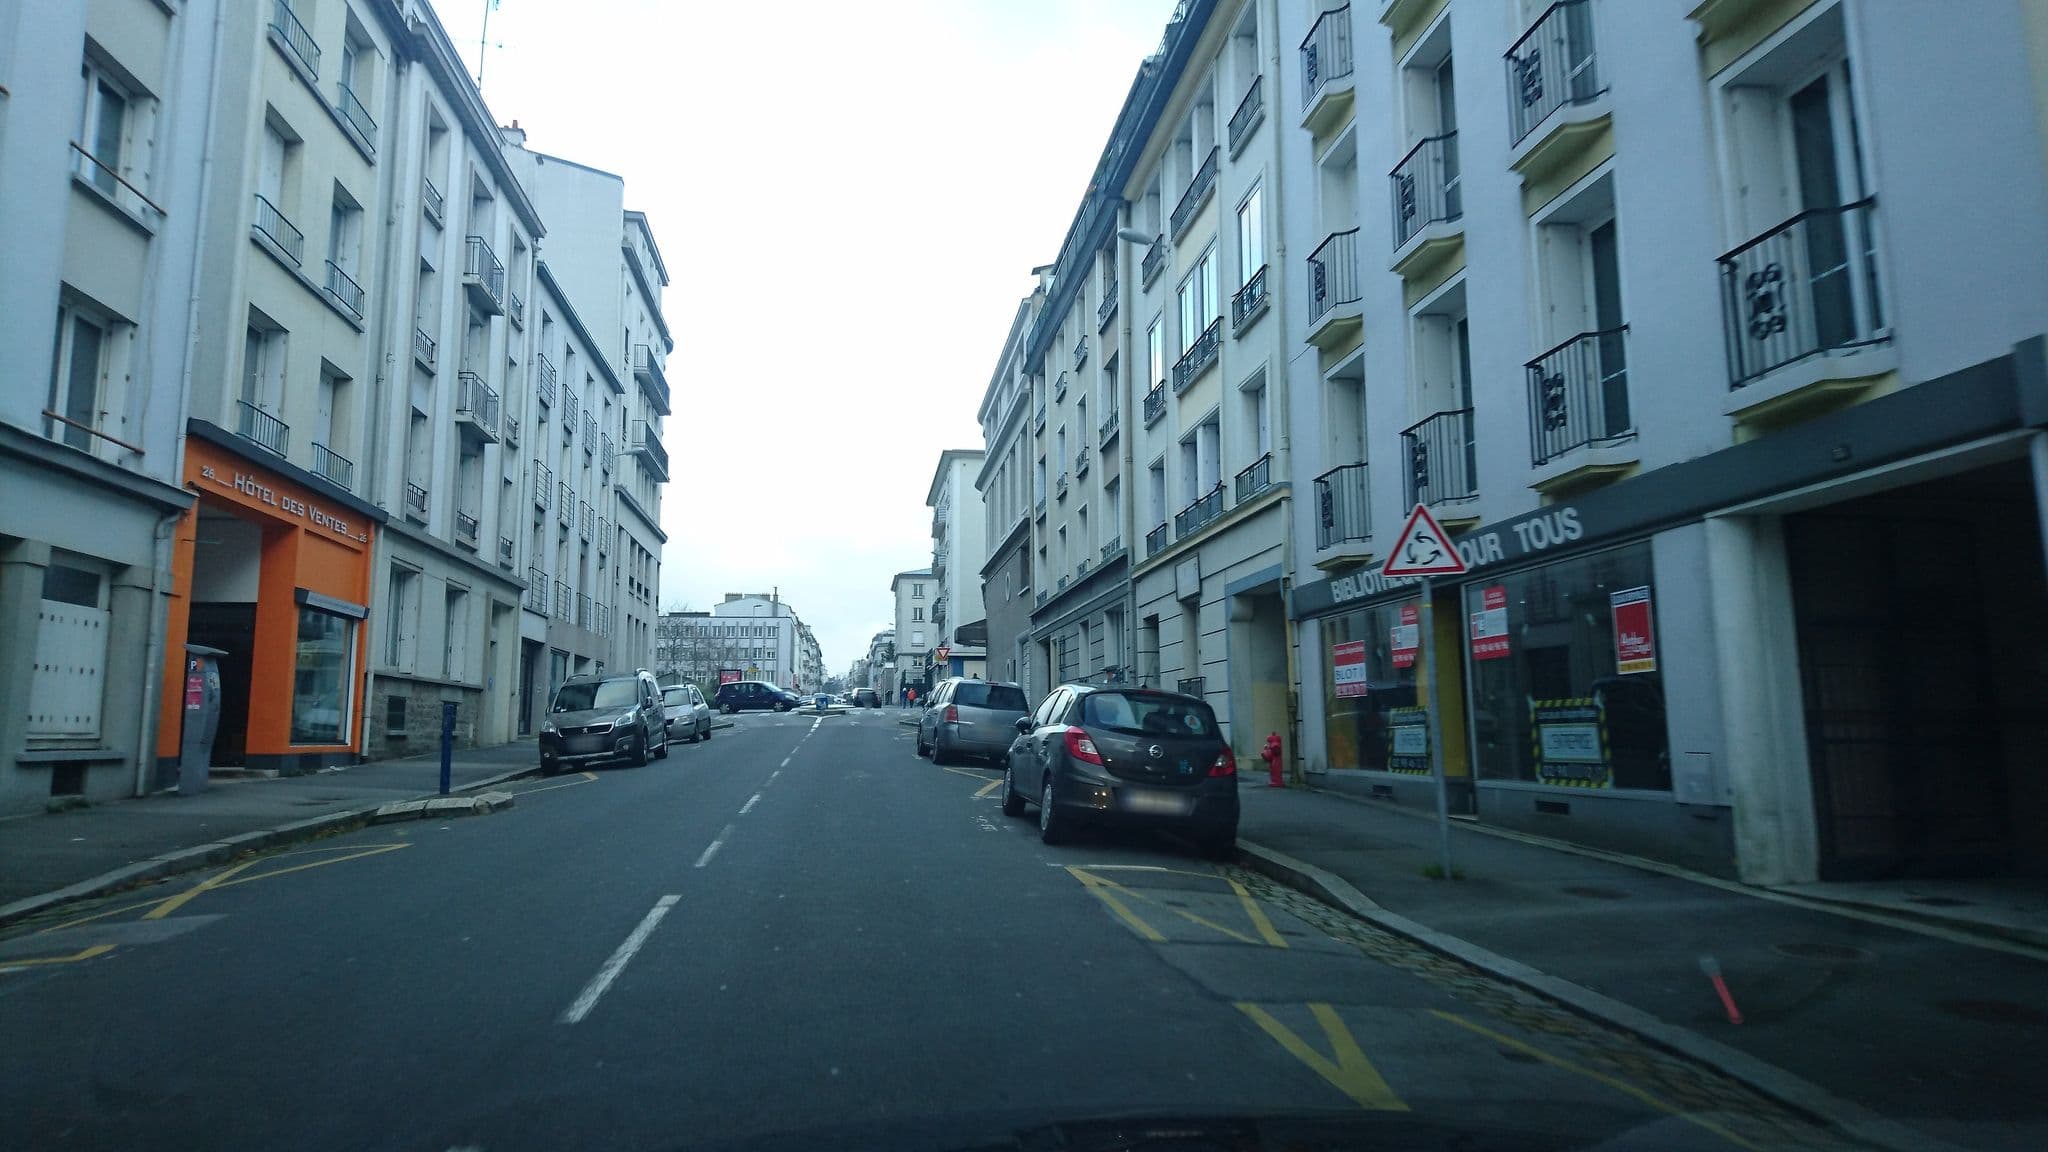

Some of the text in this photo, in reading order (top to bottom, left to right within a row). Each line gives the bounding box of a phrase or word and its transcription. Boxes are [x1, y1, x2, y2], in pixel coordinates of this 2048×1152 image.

[234, 473, 278, 506] HÔTEL
[281, 496, 305, 517] DES
[308, 504, 347, 535] VENTES
[1457, 532, 1504, 569] OUR
[1512, 507, 1583, 553] TOUS
